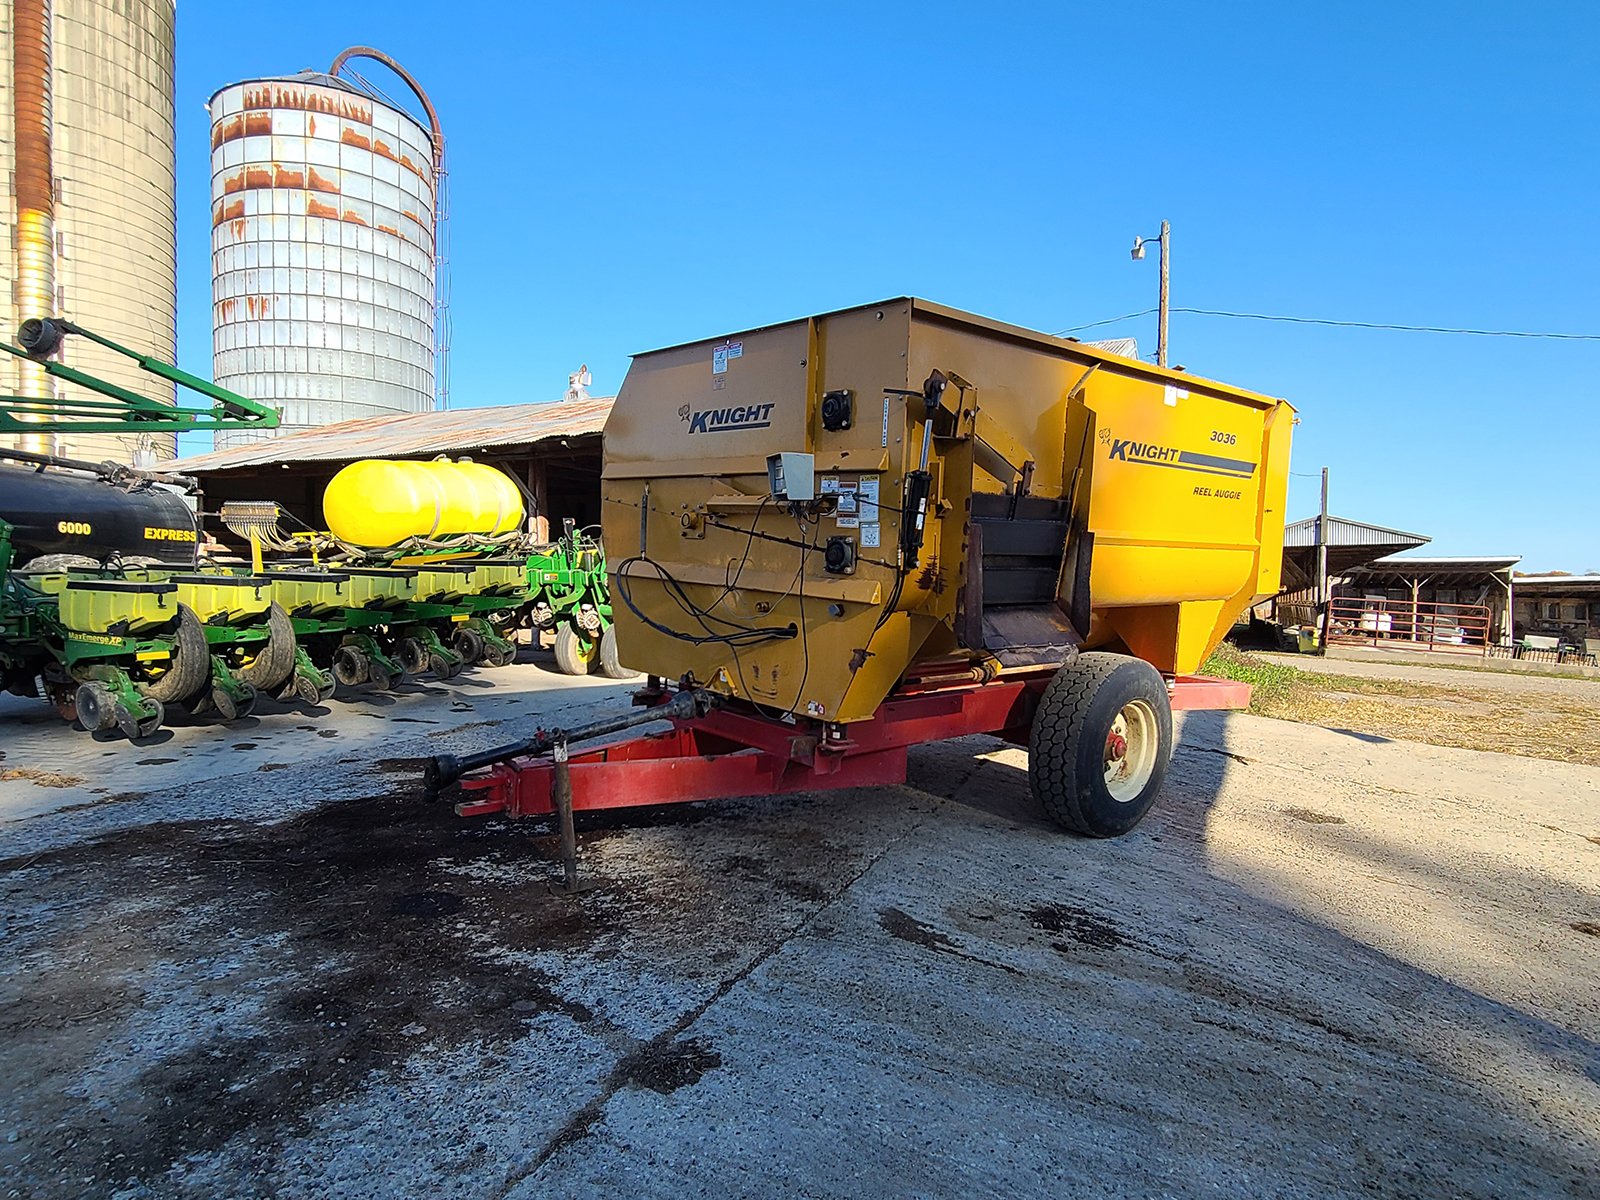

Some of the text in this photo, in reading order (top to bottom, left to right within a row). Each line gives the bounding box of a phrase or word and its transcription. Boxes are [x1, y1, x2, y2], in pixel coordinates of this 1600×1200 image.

[688, 403, 775, 434] KNIGHT
[1209, 430, 1237, 446] 3036
[1109, 439, 1179, 461] KNIGHT
[1193, 486, 1242, 500] REEL AUGGIE
[57, 521, 92, 536] 6000
[144, 527, 197, 542] EXPRESS
